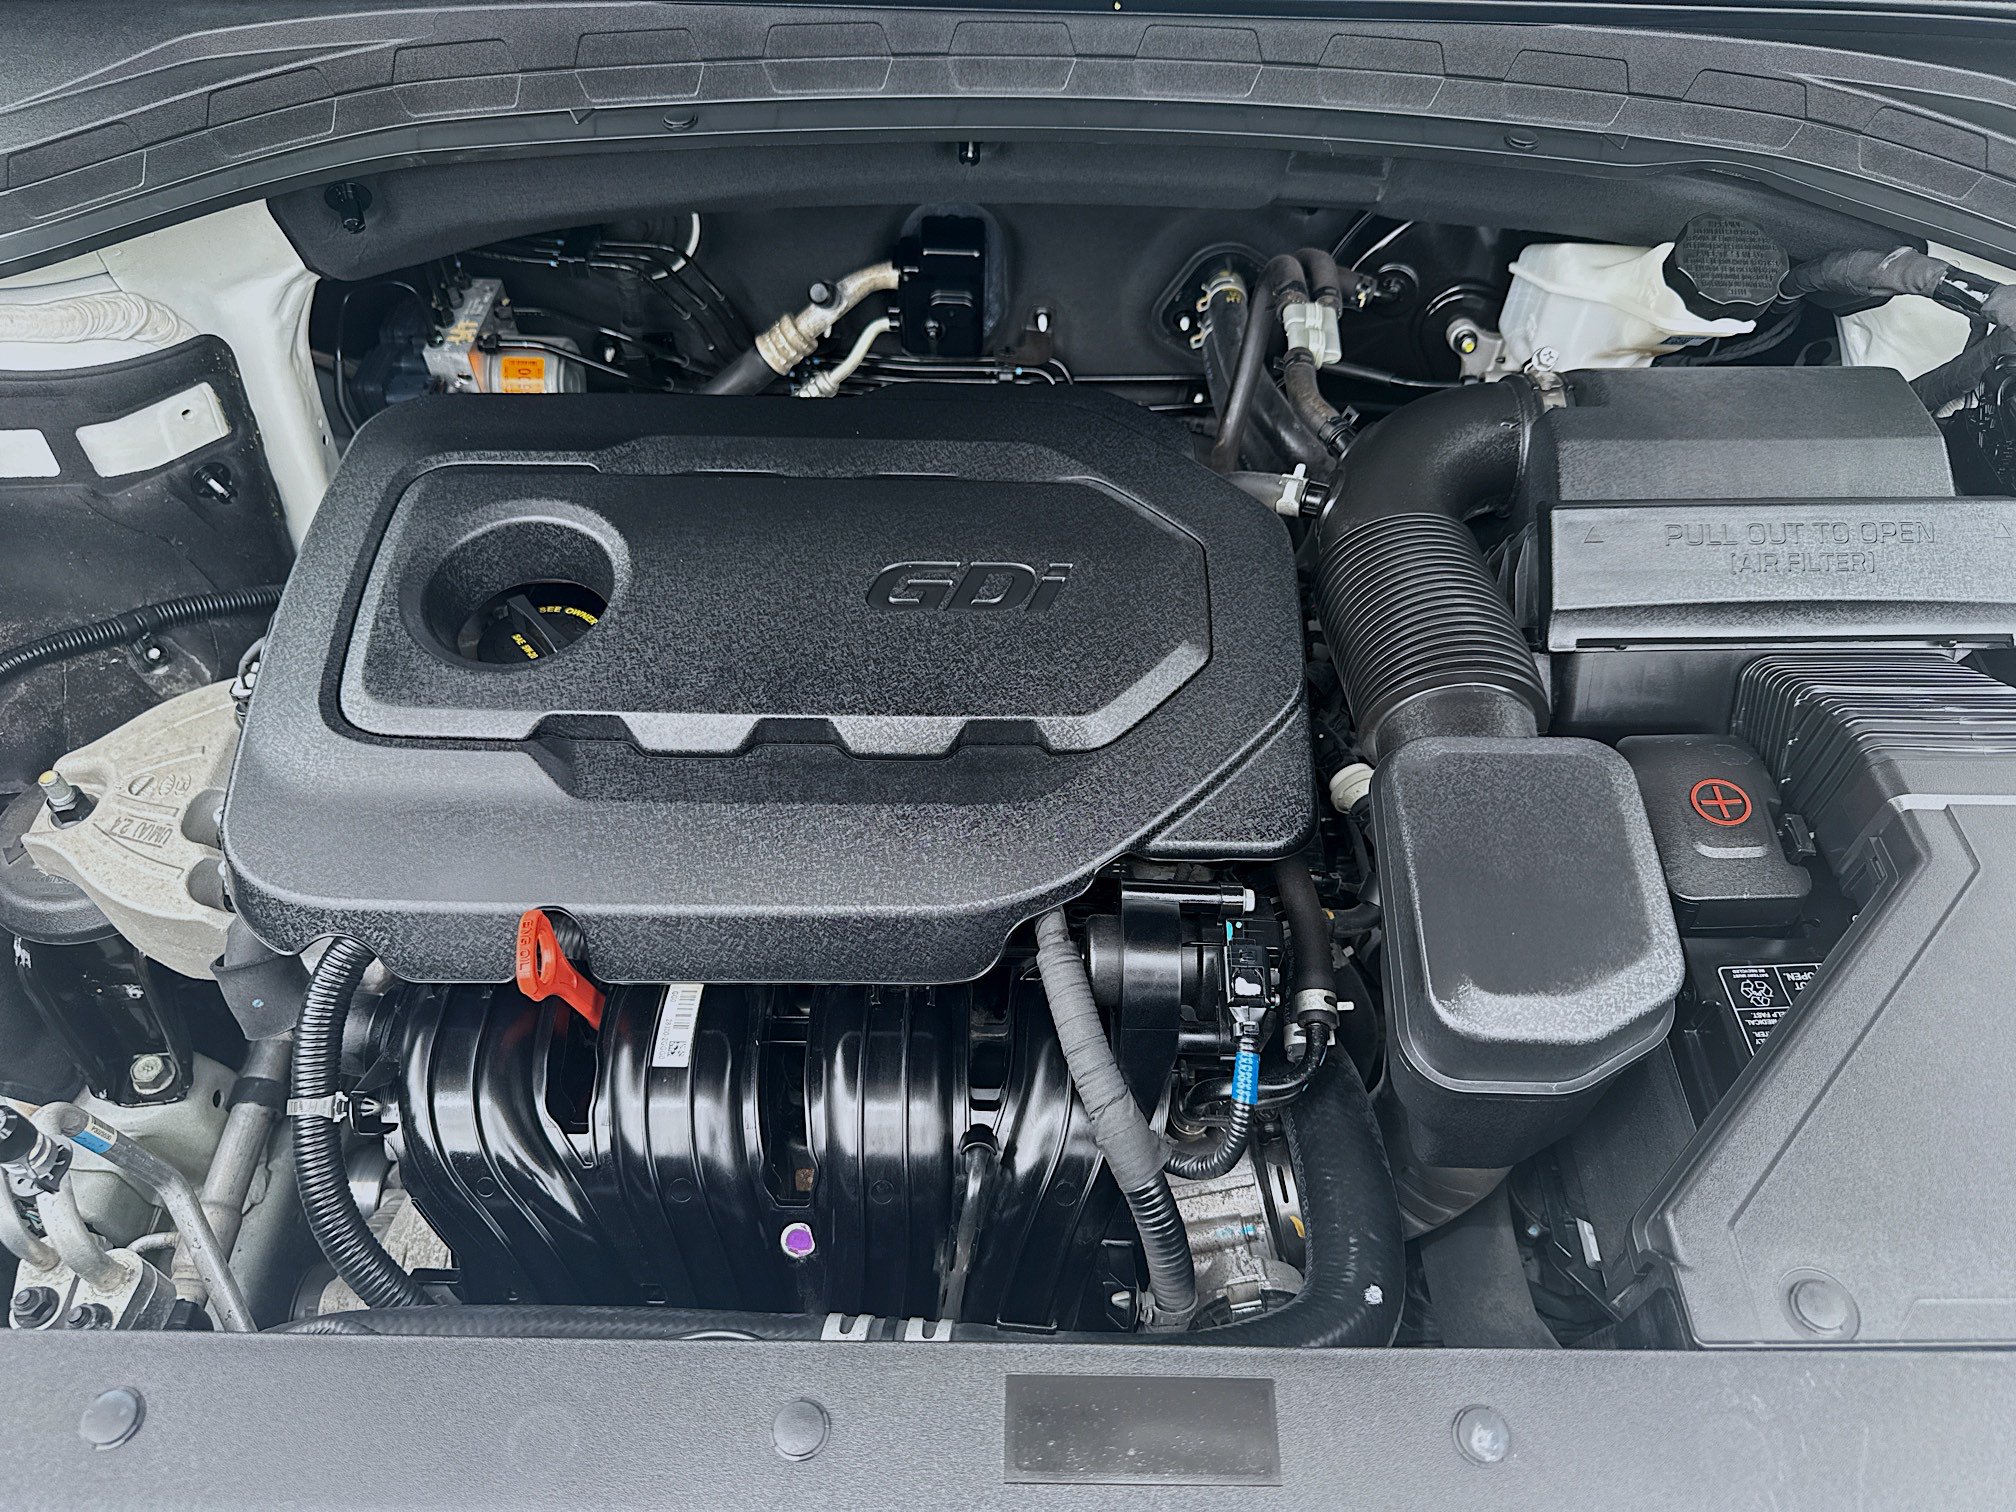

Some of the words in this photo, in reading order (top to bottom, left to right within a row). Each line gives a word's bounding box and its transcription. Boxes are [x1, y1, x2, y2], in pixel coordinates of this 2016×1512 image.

[1664, 523, 1738, 547] PULL
[1747, 522, 1804, 545] OUT
[1812, 521, 1850, 544] TO
[1860, 520, 1936, 545] OPEN
[866, 560, 1074, 612] GDi
[539, 606, 561, 614] SEE
[520, 920, 534, 945] ENG
[519, 949, 531, 971] OIL
